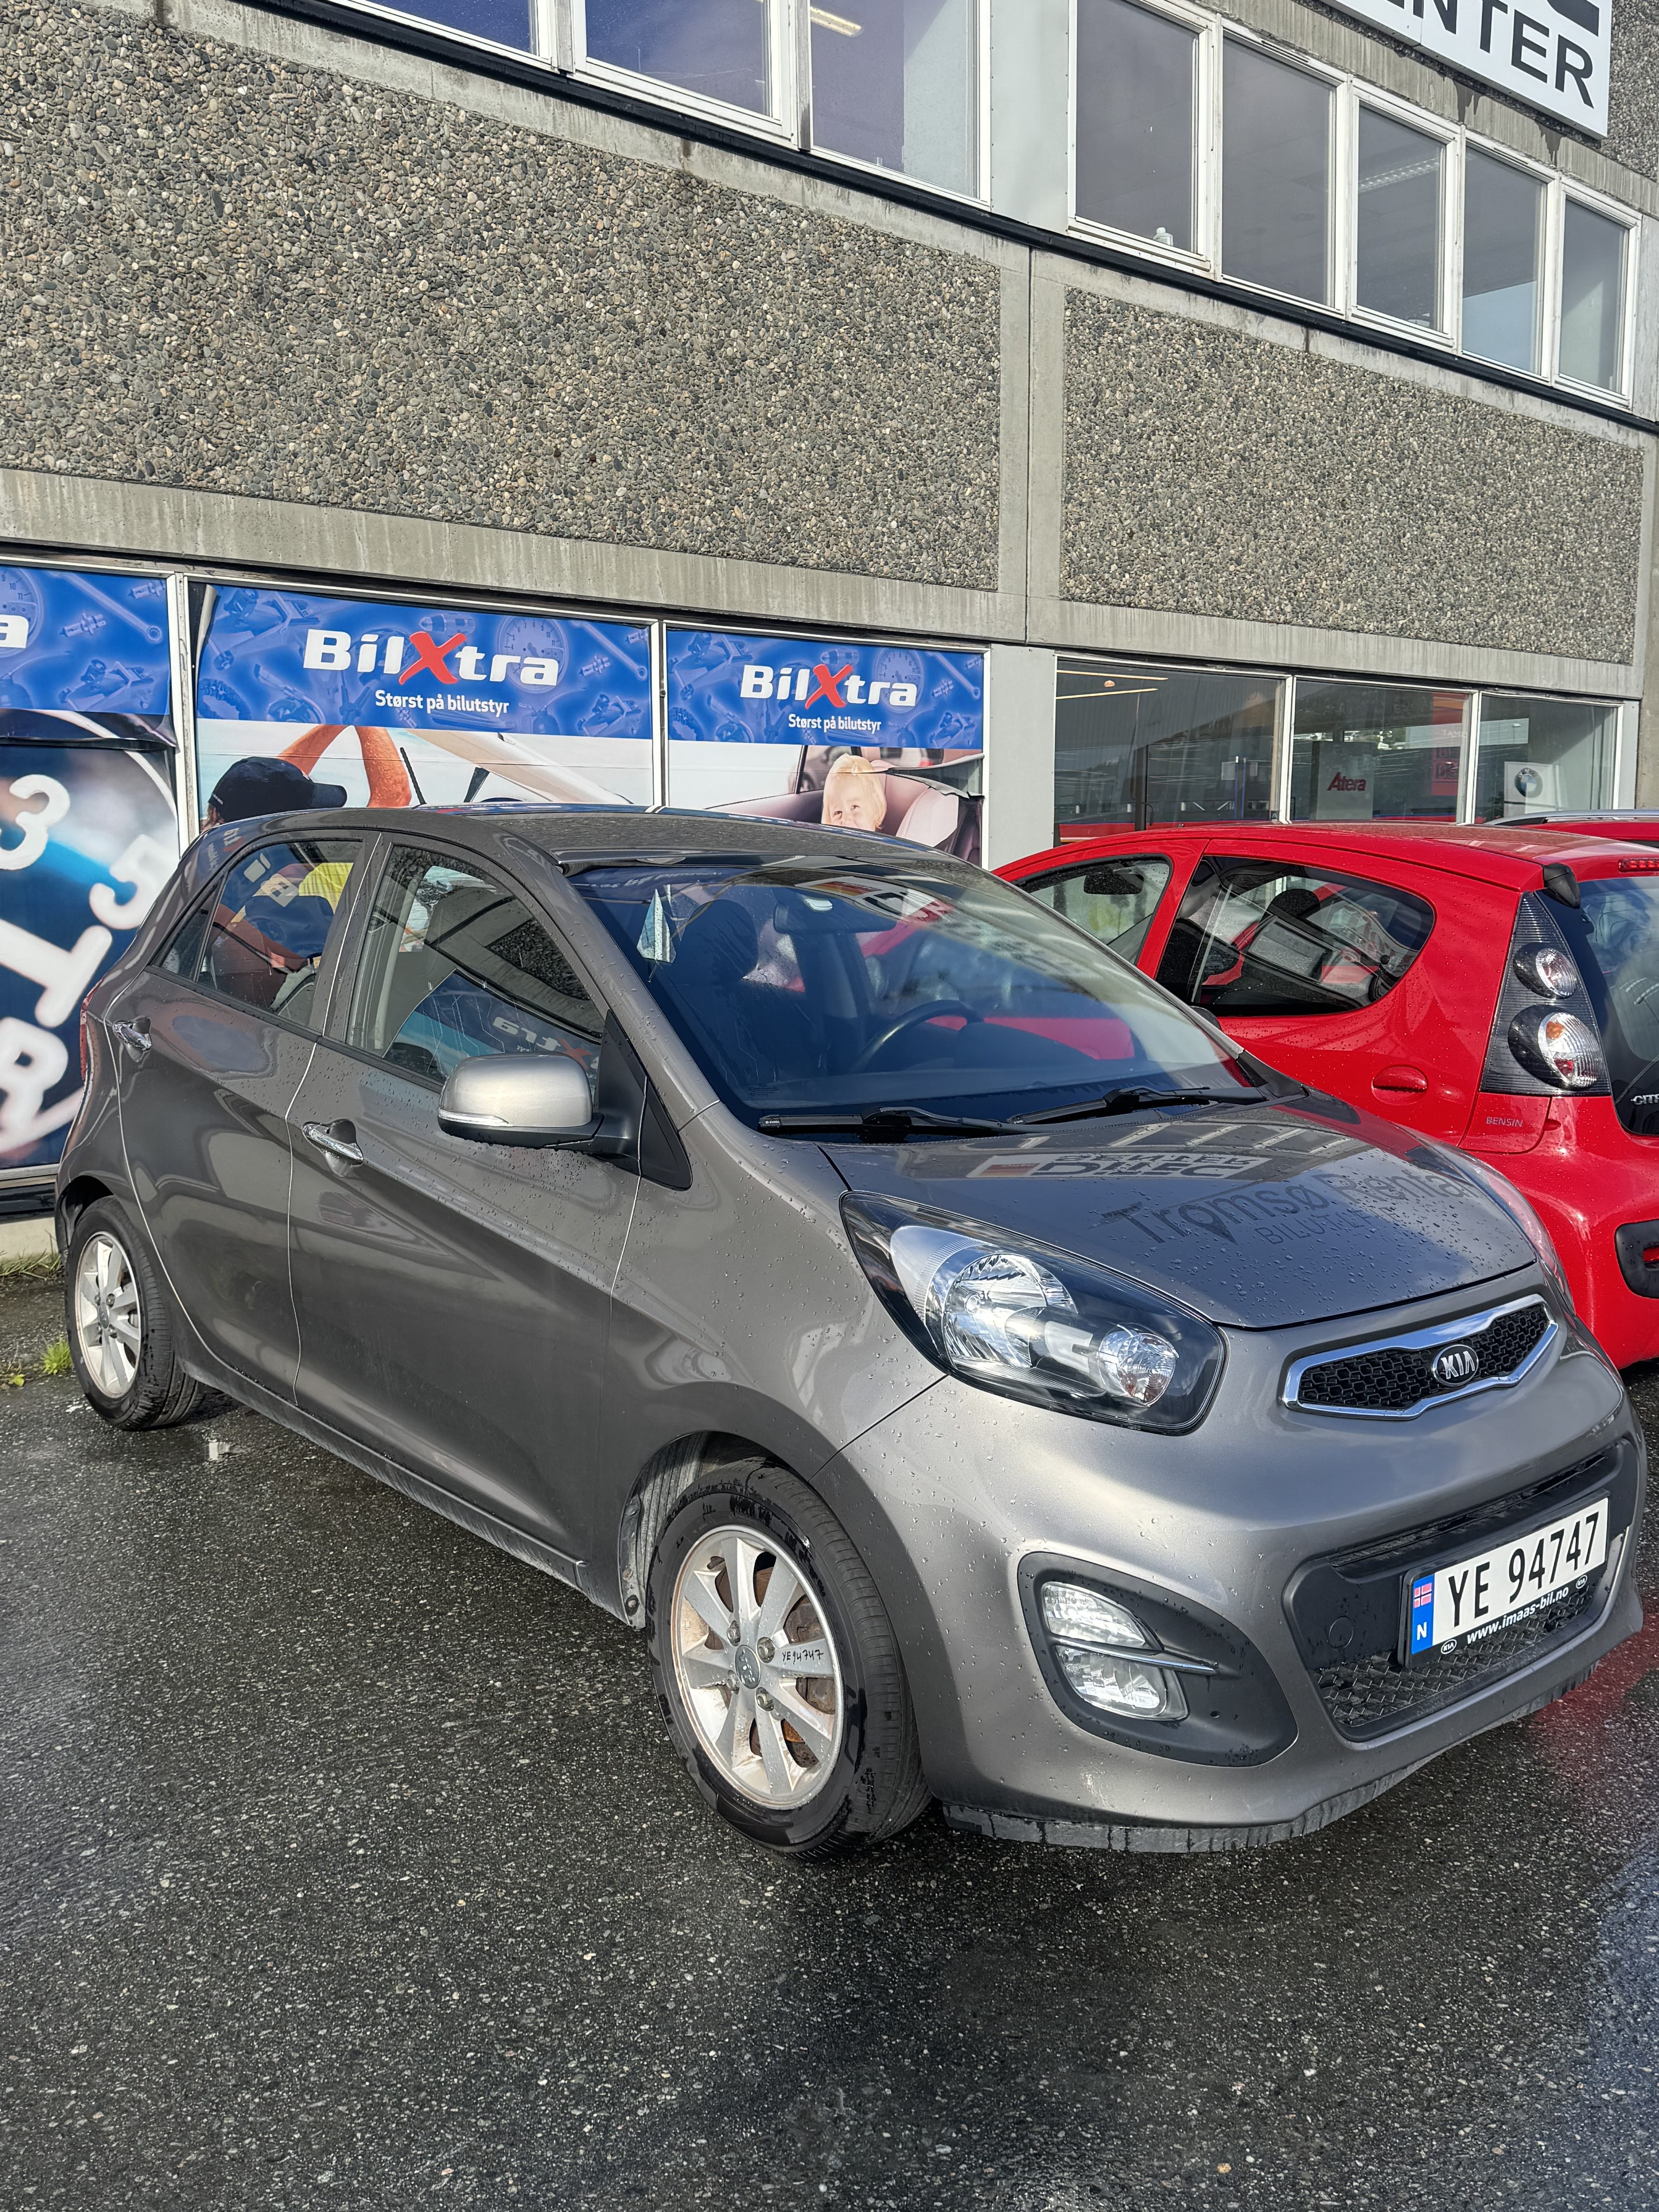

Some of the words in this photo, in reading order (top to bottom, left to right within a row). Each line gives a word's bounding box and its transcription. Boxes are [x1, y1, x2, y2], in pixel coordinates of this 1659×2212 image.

[303, 629, 558, 685] BilXtra
[740, 664, 917, 709] BilXtra
[375, 690, 423, 709] Størst
[426, 694, 445, 714] på
[447, 694, 509, 718] bilutstyr
[788, 714, 822, 730] Størst
[824, 716, 835, 733] på
[838, 716, 882, 734] bilutstyr
[1327, 772, 1367, 791] Atera
[1486, 1116, 1523, 1127] BENSIN
[1101, 1183, 1331, 1245] Tromsø
[1440, 1350, 1475, 1379] KIA
[1448, 1561, 1490, 1628] YE
[1508, 1511, 1599, 1604] 94747
[1417, 1621, 1427, 1640] N
[1443, 1641, 1455, 1652] KIA
[1467, 1586, 1569, 1645] www.imaas-bil.no
